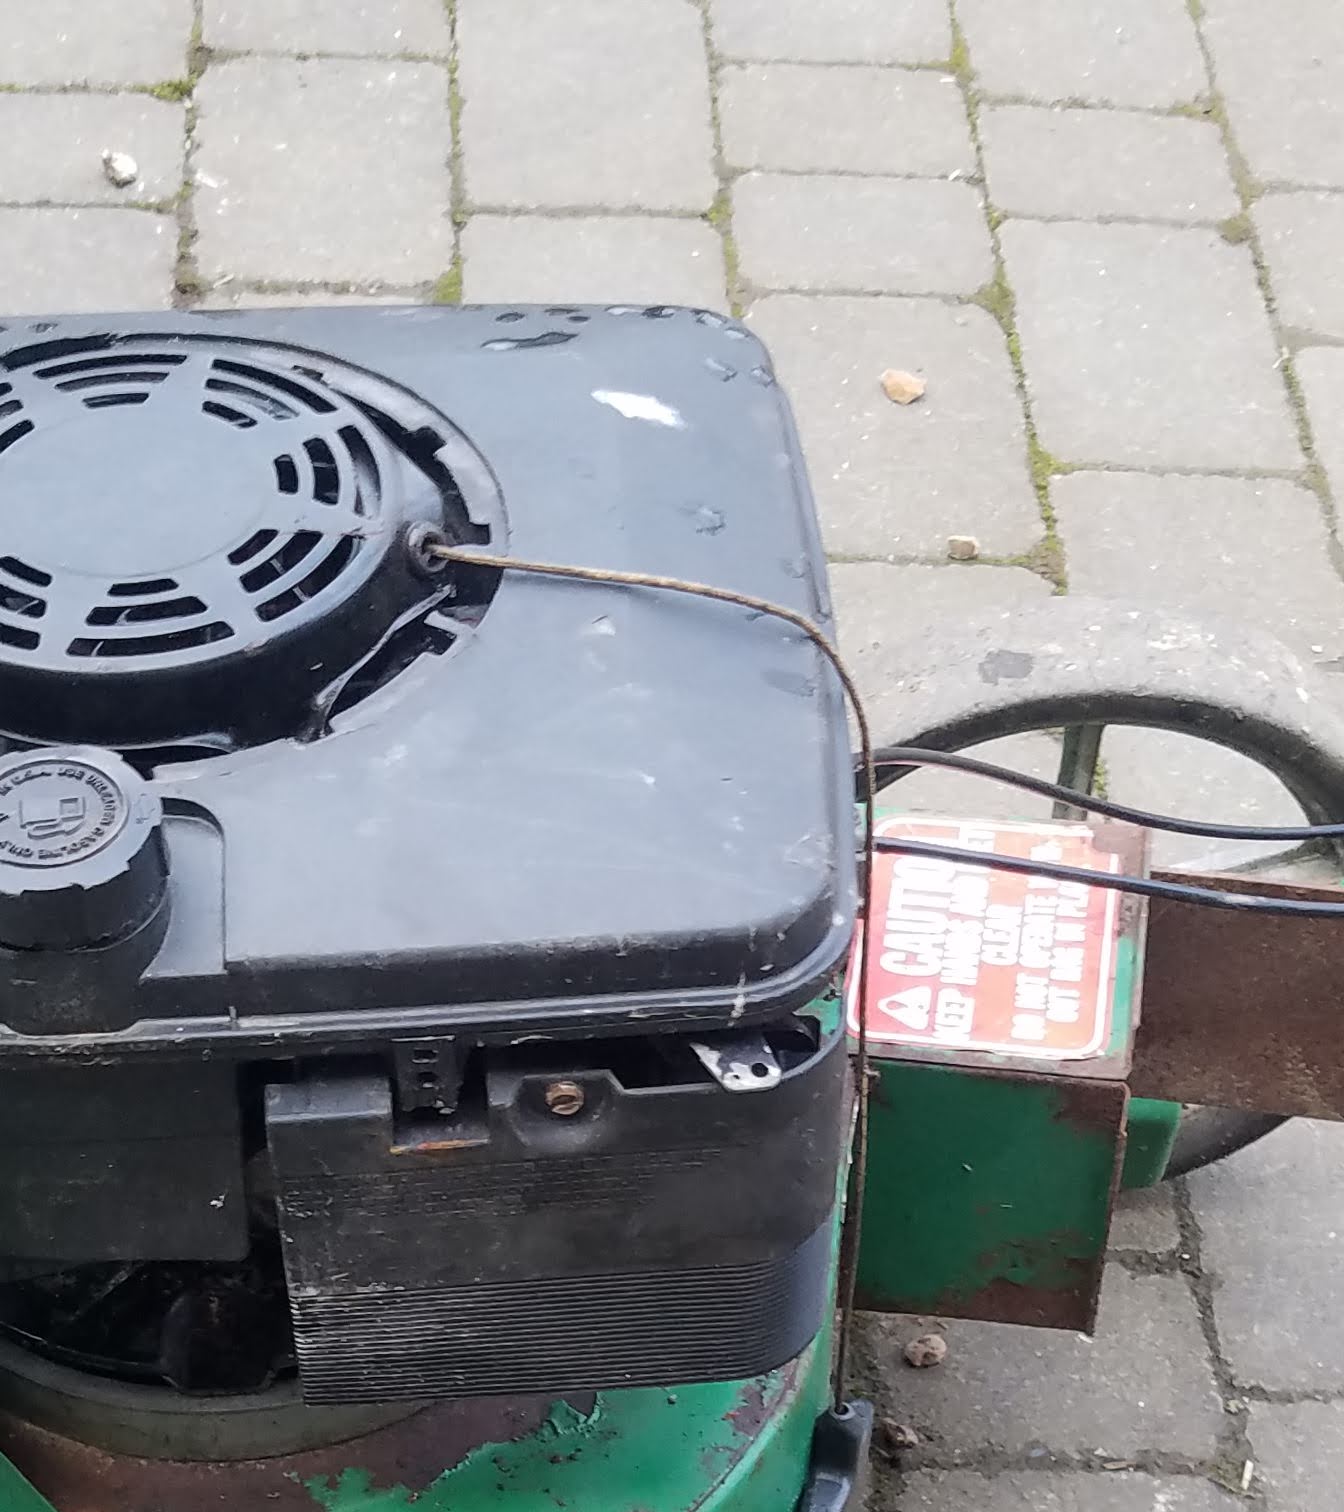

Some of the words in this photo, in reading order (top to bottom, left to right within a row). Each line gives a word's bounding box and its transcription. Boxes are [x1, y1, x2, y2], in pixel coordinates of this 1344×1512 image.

[940, 919, 984, 985] HANDS
[980, 904, 1023, 965] CLEAR
[1018, 894, 1058, 968] OPERATE
[932, 987, 975, 1041] KEEP
[1015, 972, 1049, 1010] NOT
